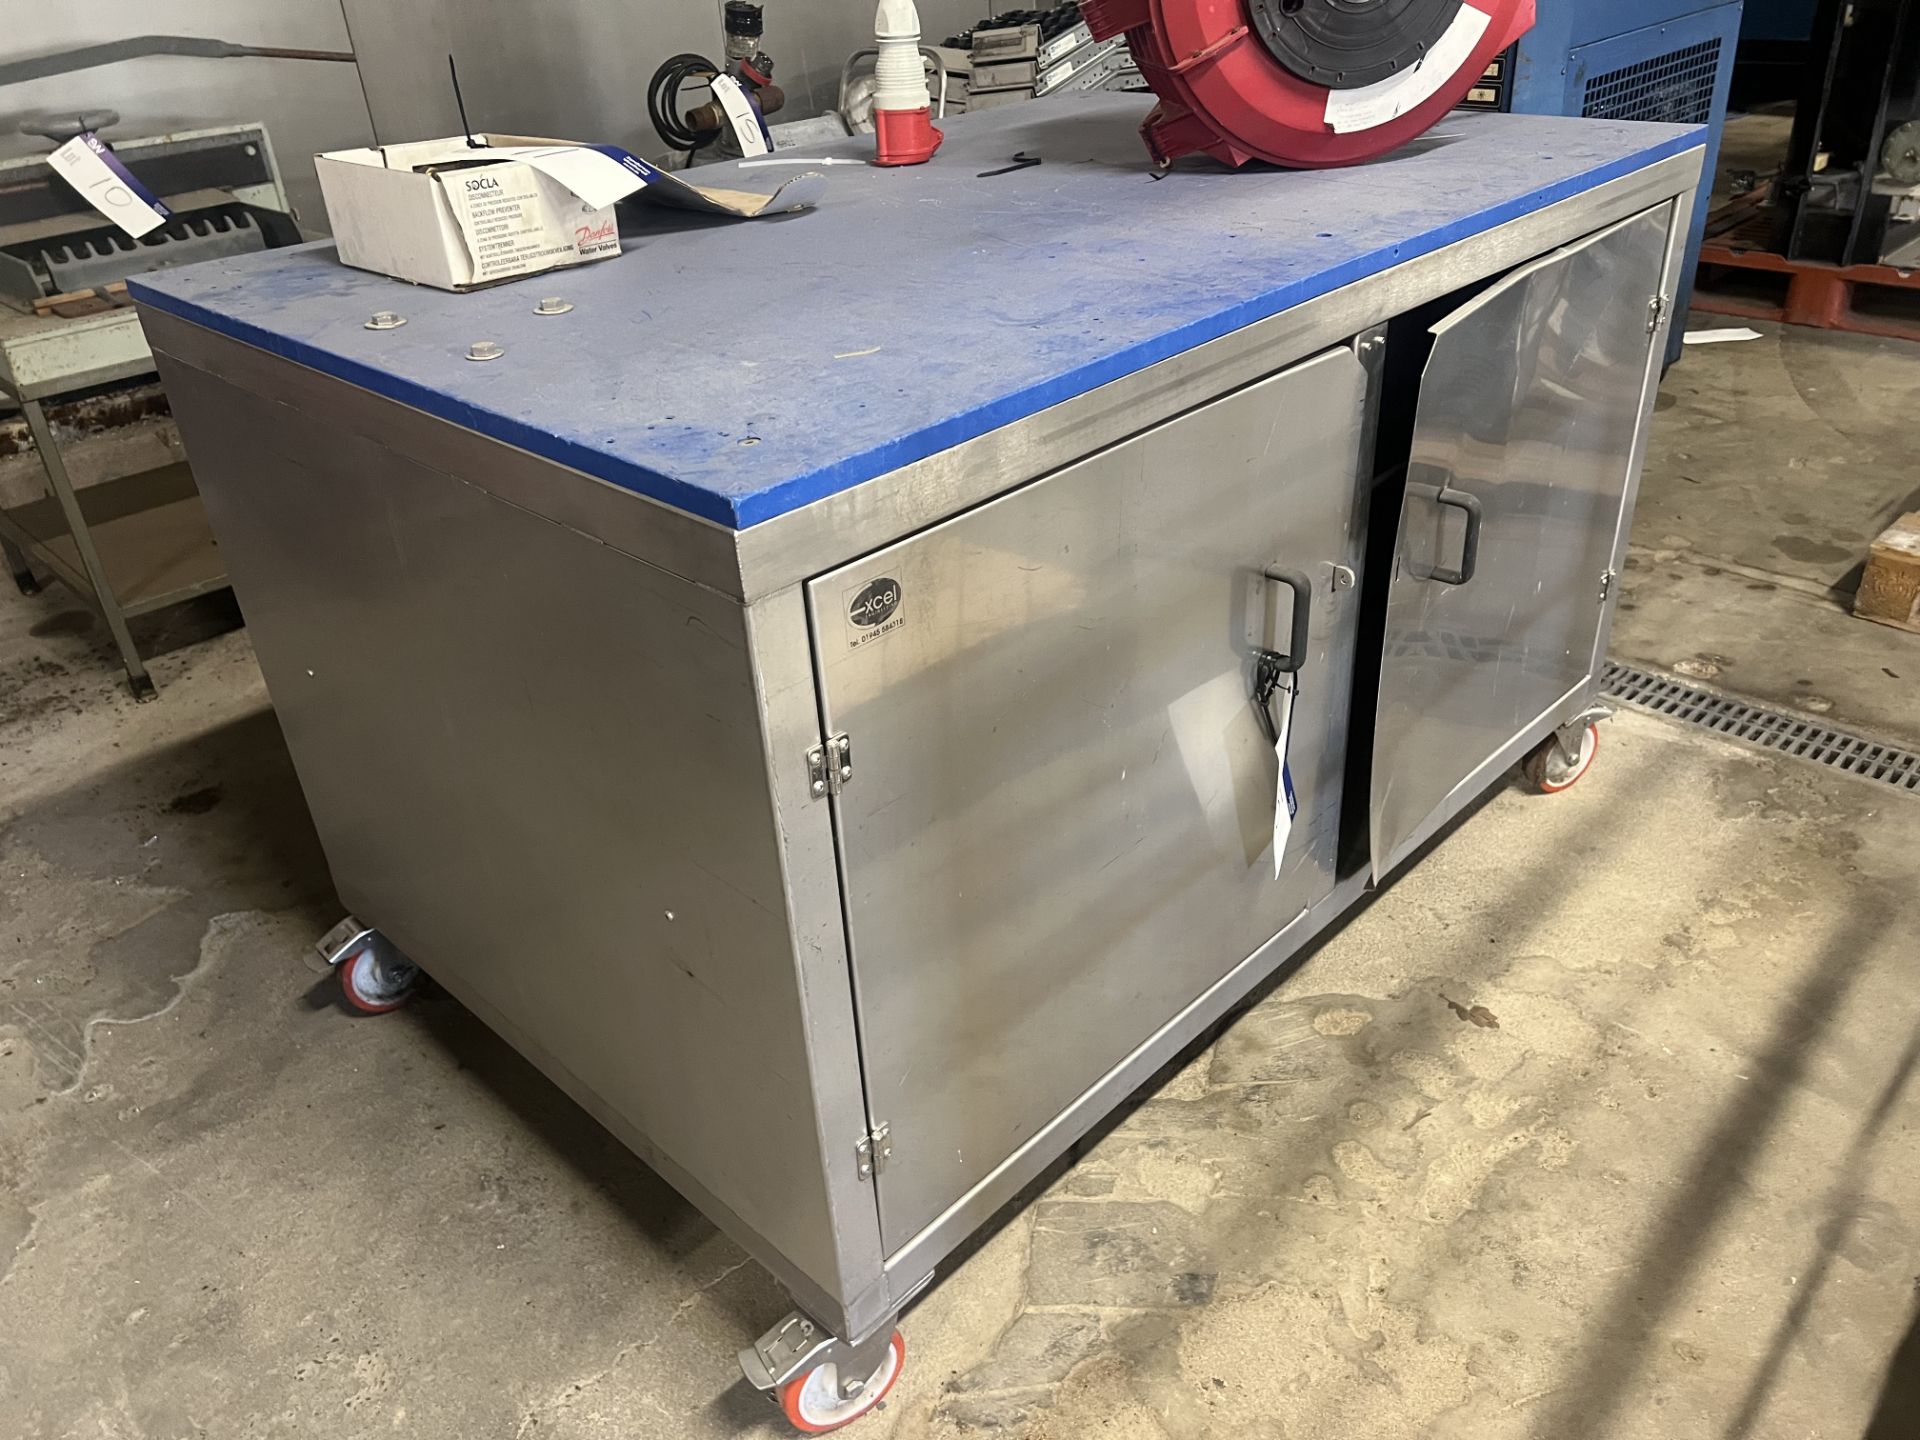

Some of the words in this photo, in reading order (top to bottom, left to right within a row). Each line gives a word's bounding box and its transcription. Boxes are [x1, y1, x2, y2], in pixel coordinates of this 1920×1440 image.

[465, 176, 499, 192] SOCLA
[89, 178, 133, 208] 10
[579, 247, 597, 256] Water
[598, 243, 617, 251] Valves
